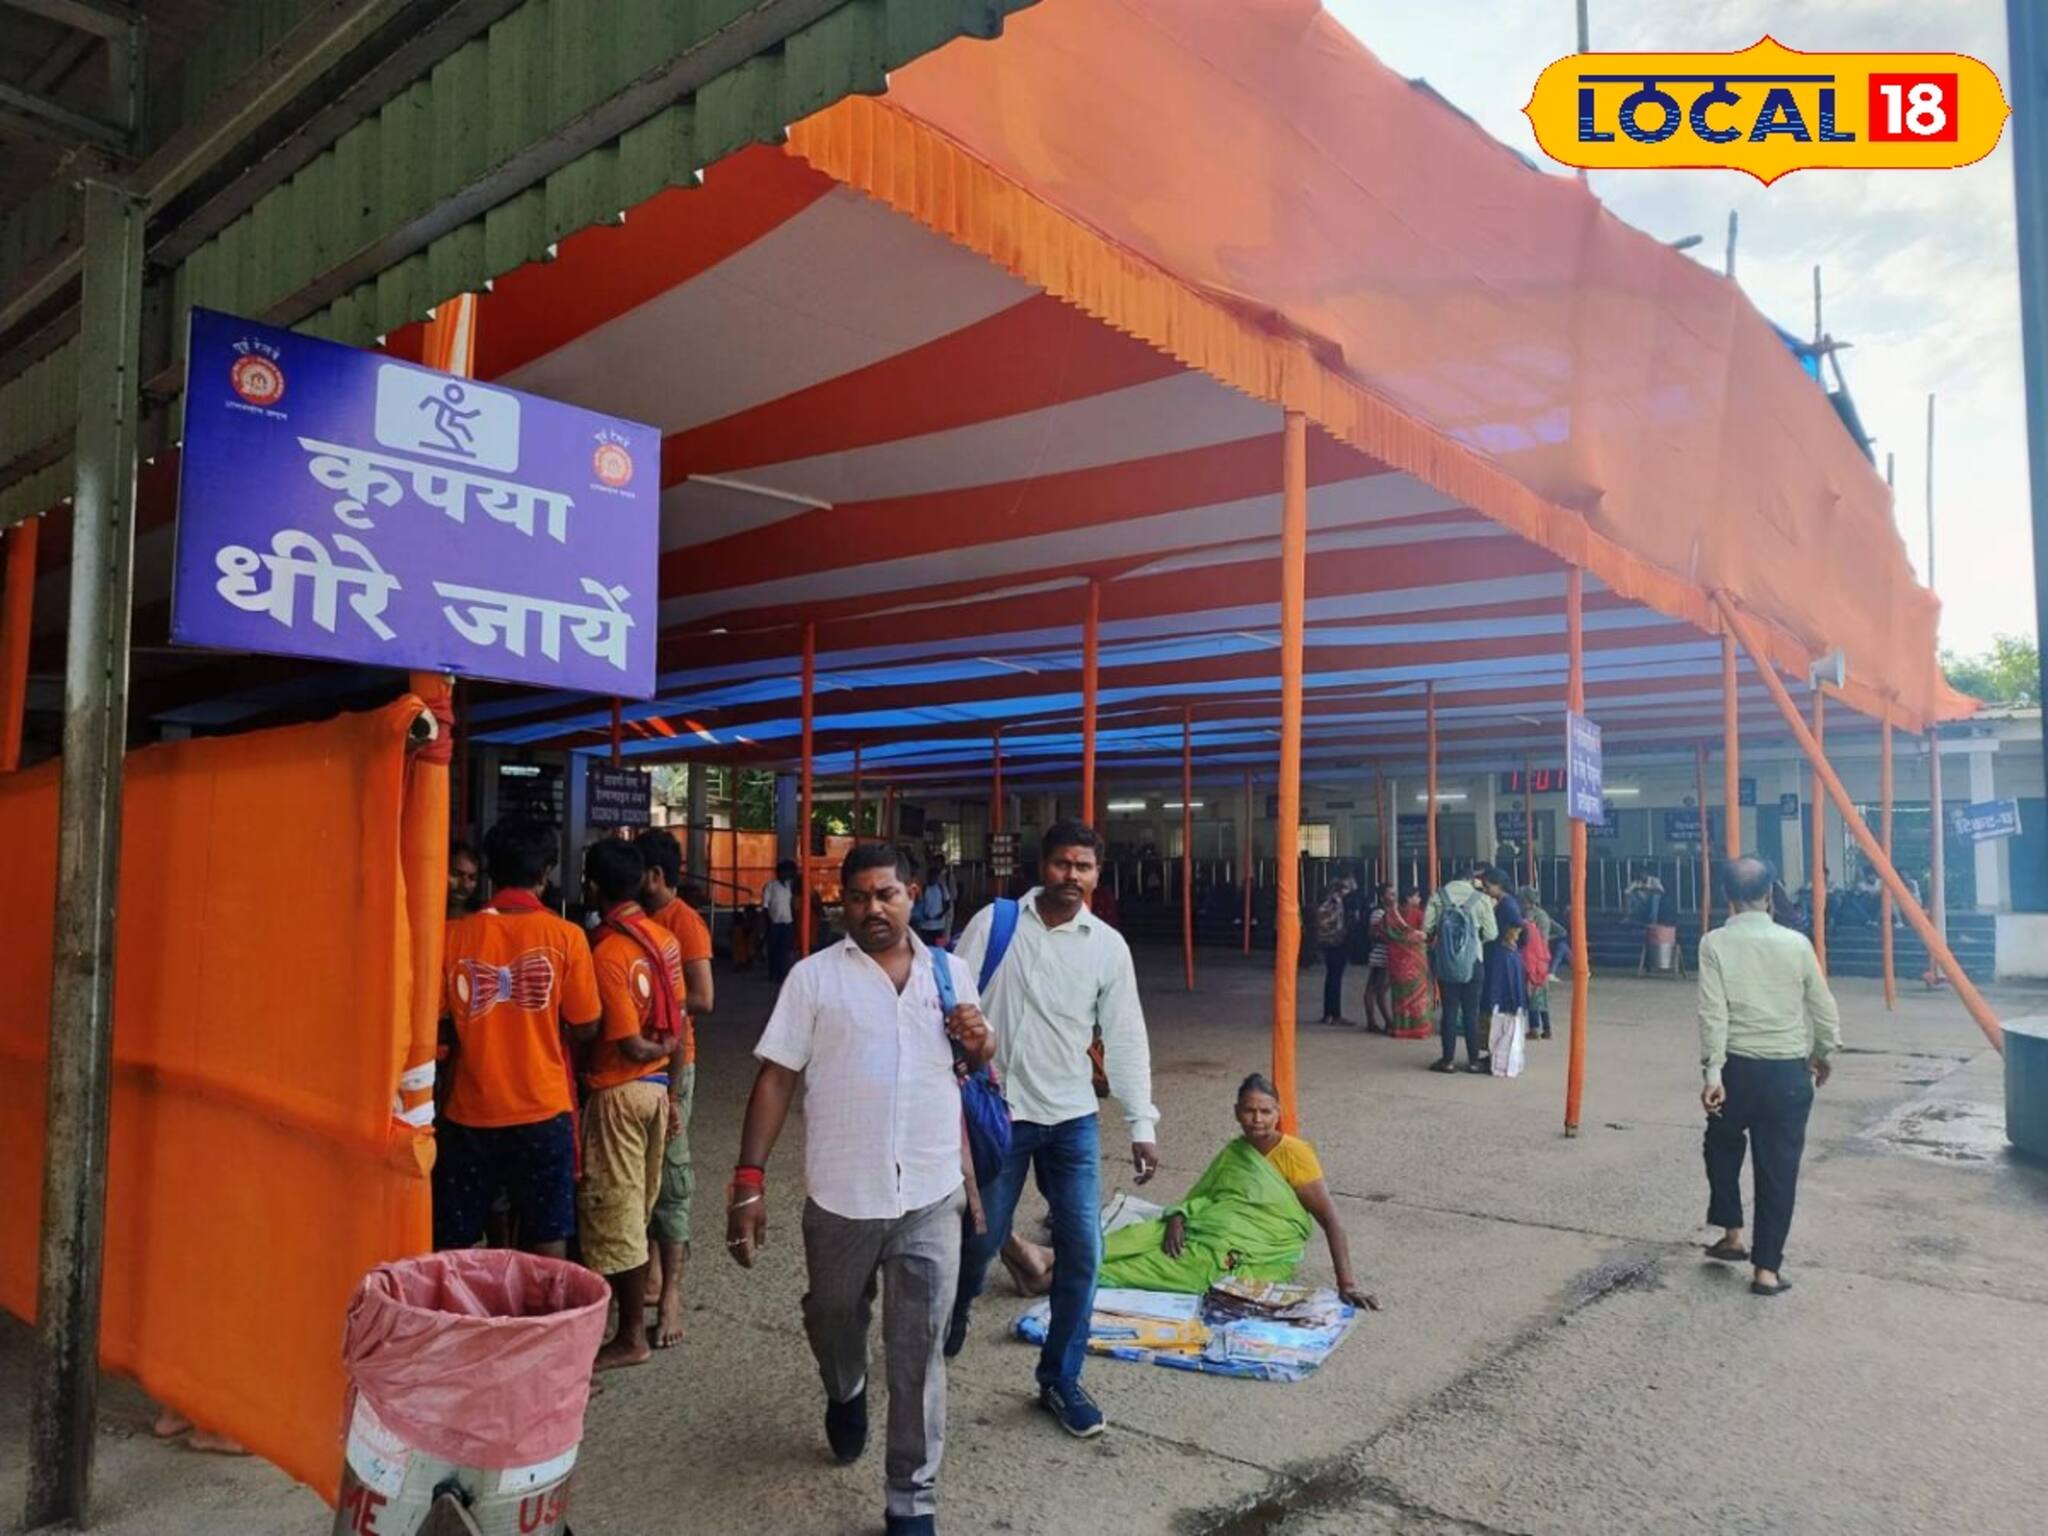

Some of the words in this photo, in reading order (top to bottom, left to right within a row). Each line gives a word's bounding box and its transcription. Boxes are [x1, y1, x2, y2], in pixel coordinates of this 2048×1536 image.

[297, 436, 575, 544] कृपया
[214, 529, 401, 641] धीरे
[433, 577, 635, 671] जायें
